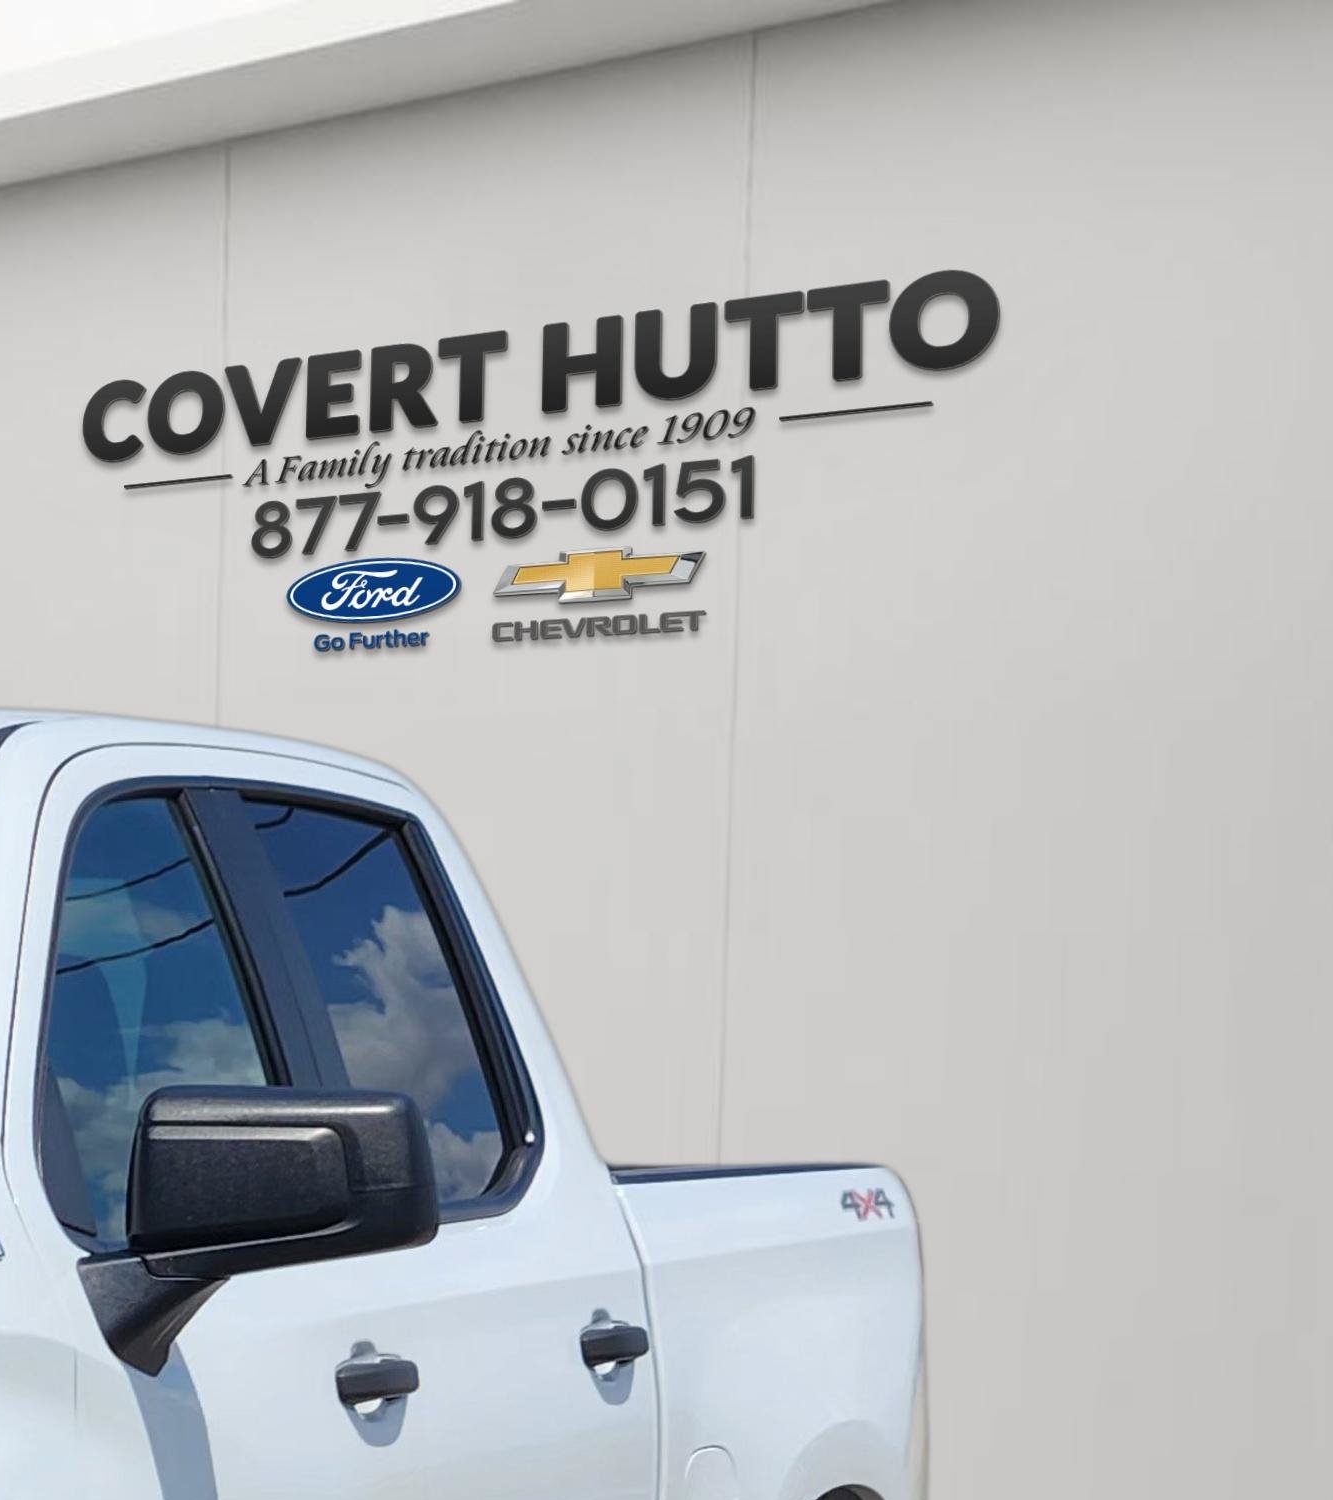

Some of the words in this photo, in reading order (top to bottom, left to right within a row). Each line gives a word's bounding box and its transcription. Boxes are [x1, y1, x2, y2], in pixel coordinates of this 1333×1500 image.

[82, 330, 509, 464] COVERT
[541, 268, 1001, 413] HUTTO
[242, 458, 269, 487] A
[274, 441, 393, 488] Family
[401, 430, 551, 472] tradition
[561, 424, 649, 456] since
[656, 406, 756, 446] 1909
[249, 455, 756, 560] 877-918-0151
[321, 569, 423, 610] Ford
[313, 633, 346, 652] Go
[349, 629, 430, 651] Further
[491, 609, 707, 644] CHEVROLET
